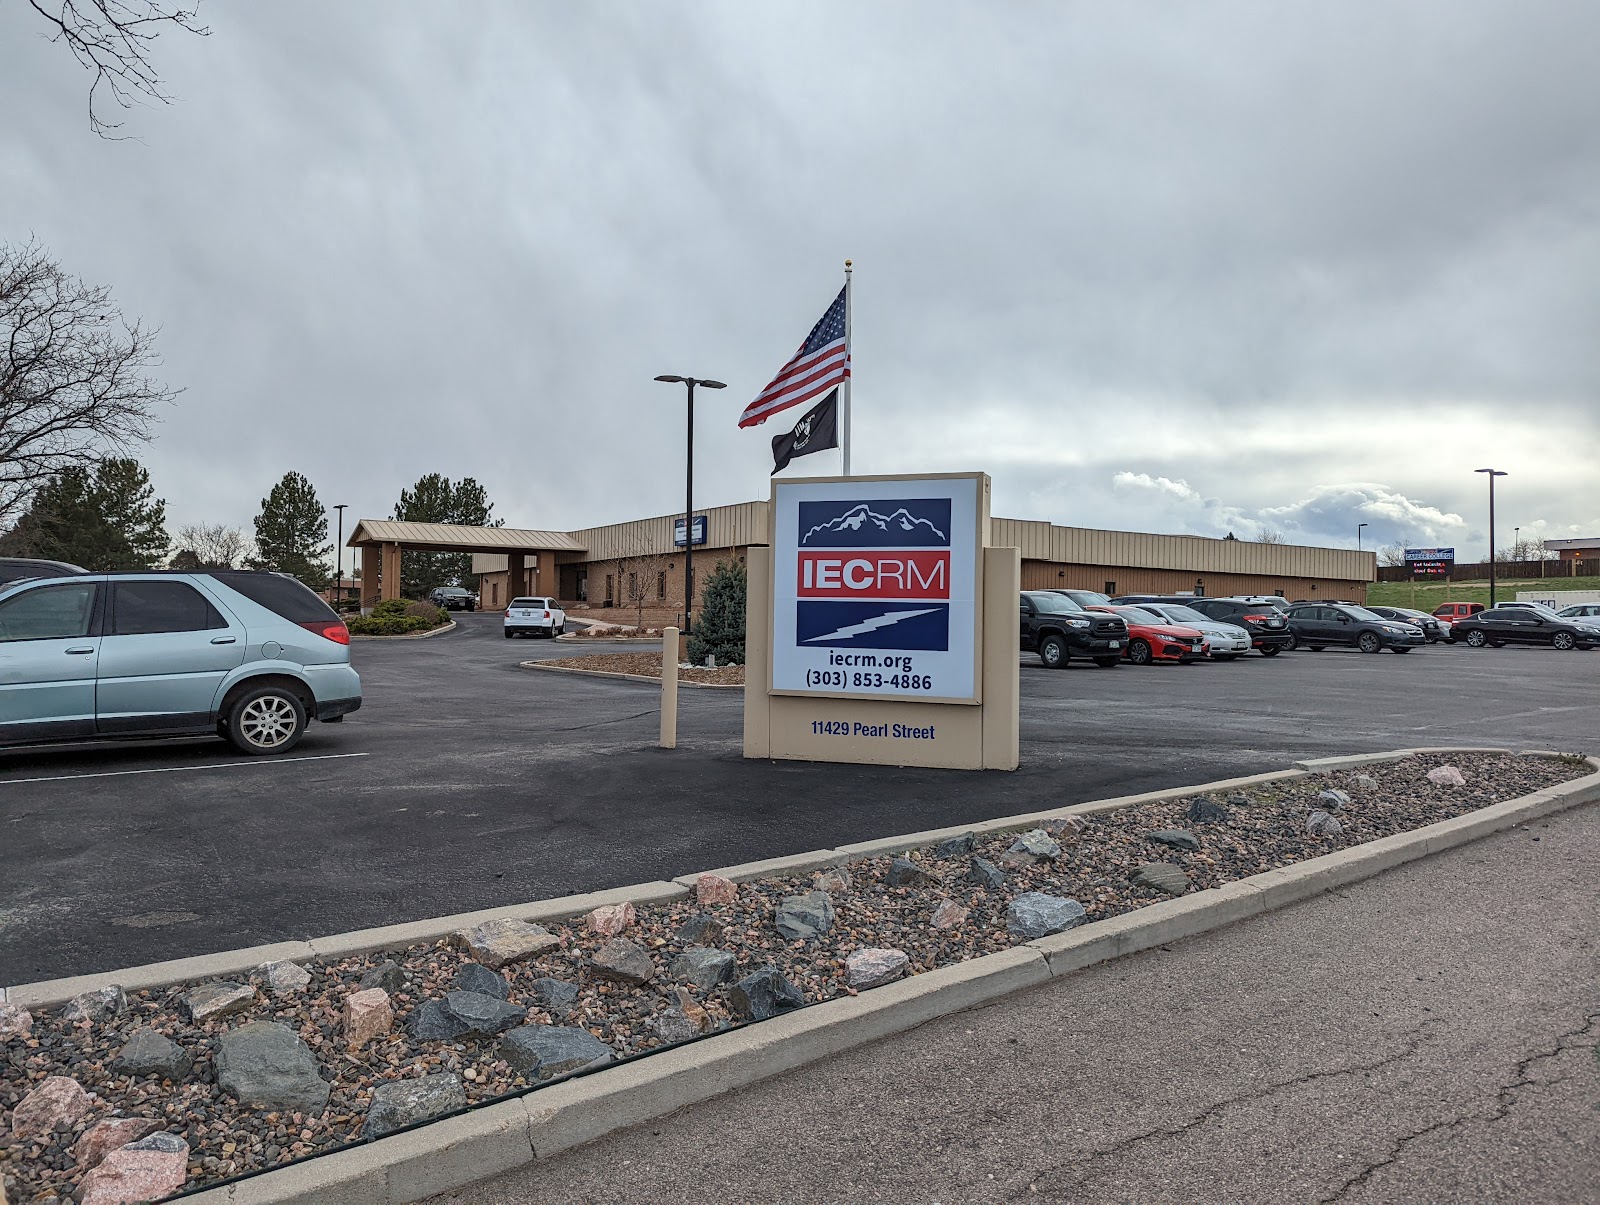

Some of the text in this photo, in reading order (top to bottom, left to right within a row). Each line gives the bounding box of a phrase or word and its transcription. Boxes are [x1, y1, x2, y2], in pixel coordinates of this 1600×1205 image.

[803, 559, 944, 590] IECRM
[829, 649, 913, 673] iecrm.org
[806, 668, 932, 691] (303) 853-4886
[811, 720, 936, 740] 11429 Pearl Street
